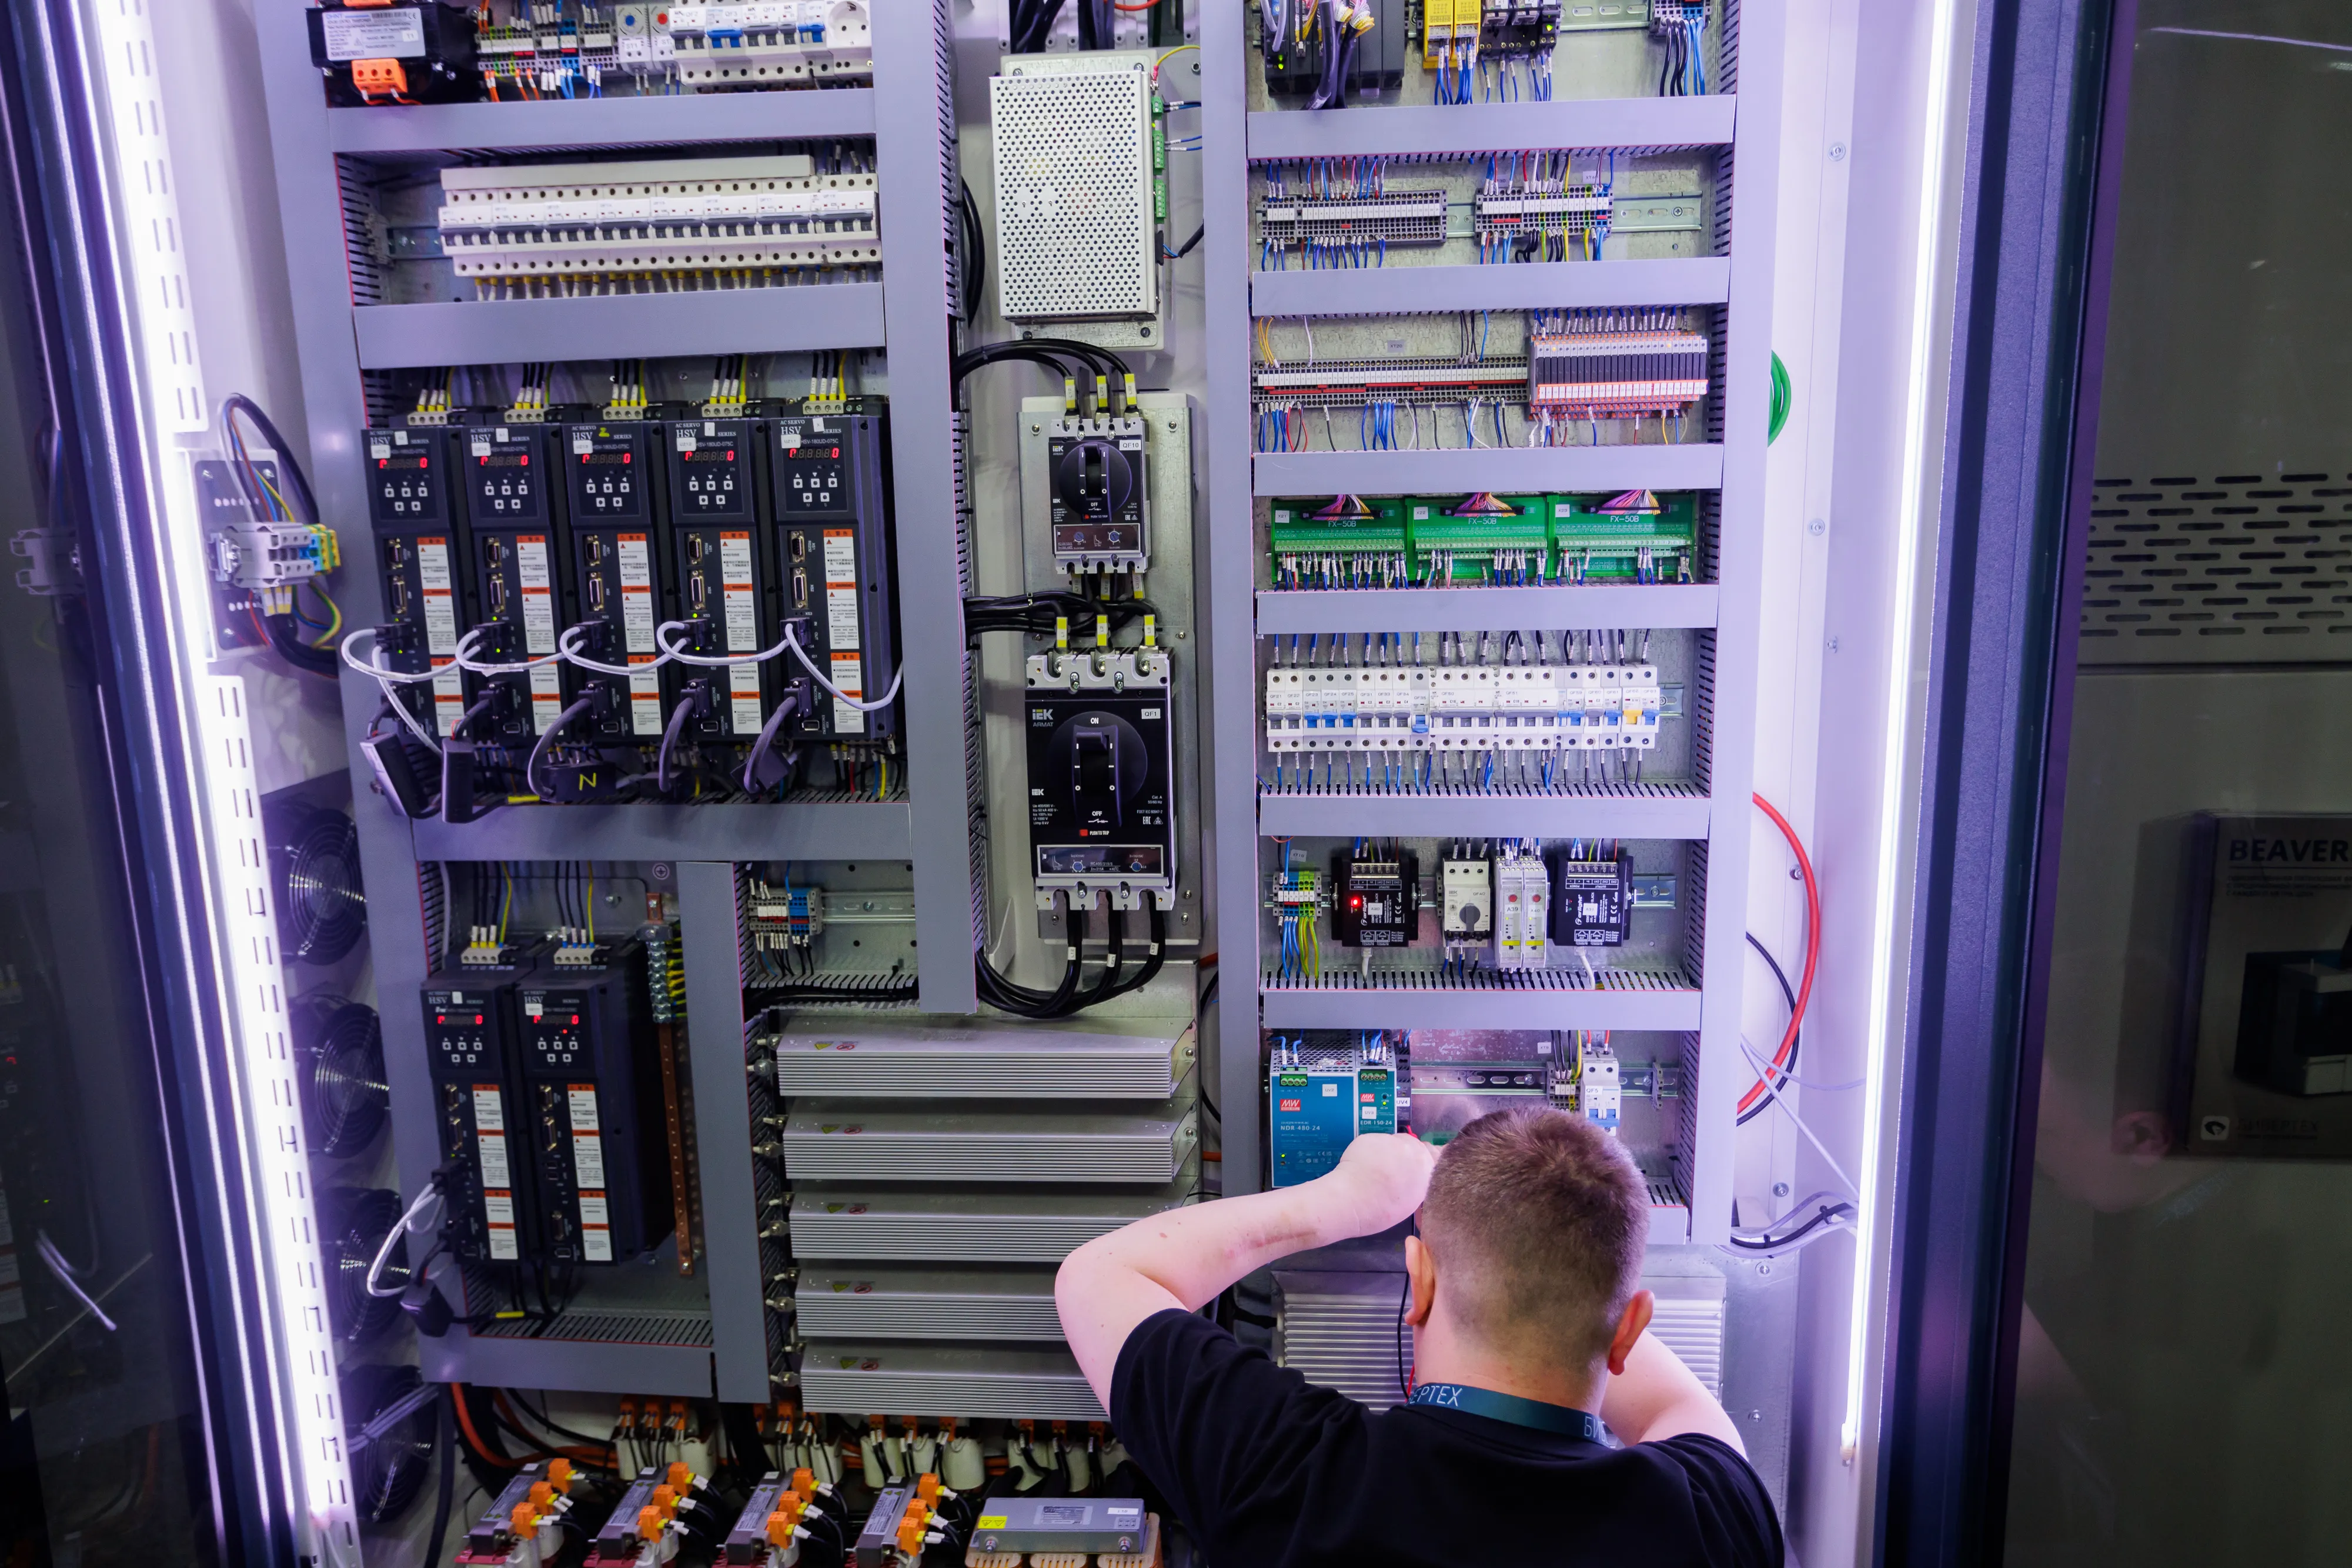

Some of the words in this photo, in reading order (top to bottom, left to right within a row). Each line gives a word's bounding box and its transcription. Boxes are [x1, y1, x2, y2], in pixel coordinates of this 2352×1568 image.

[676, 429, 697, 438] HSV
[781, 426, 801, 435] HSV
[471, 434, 491, 443] HSV
[572, 432, 593, 440] HSV
[370, 437, 390, 445] HSV
[2229, 839, 2348, 862] BEAVER
[1404, 1385, 1462, 1407] ЕРТЕХ
